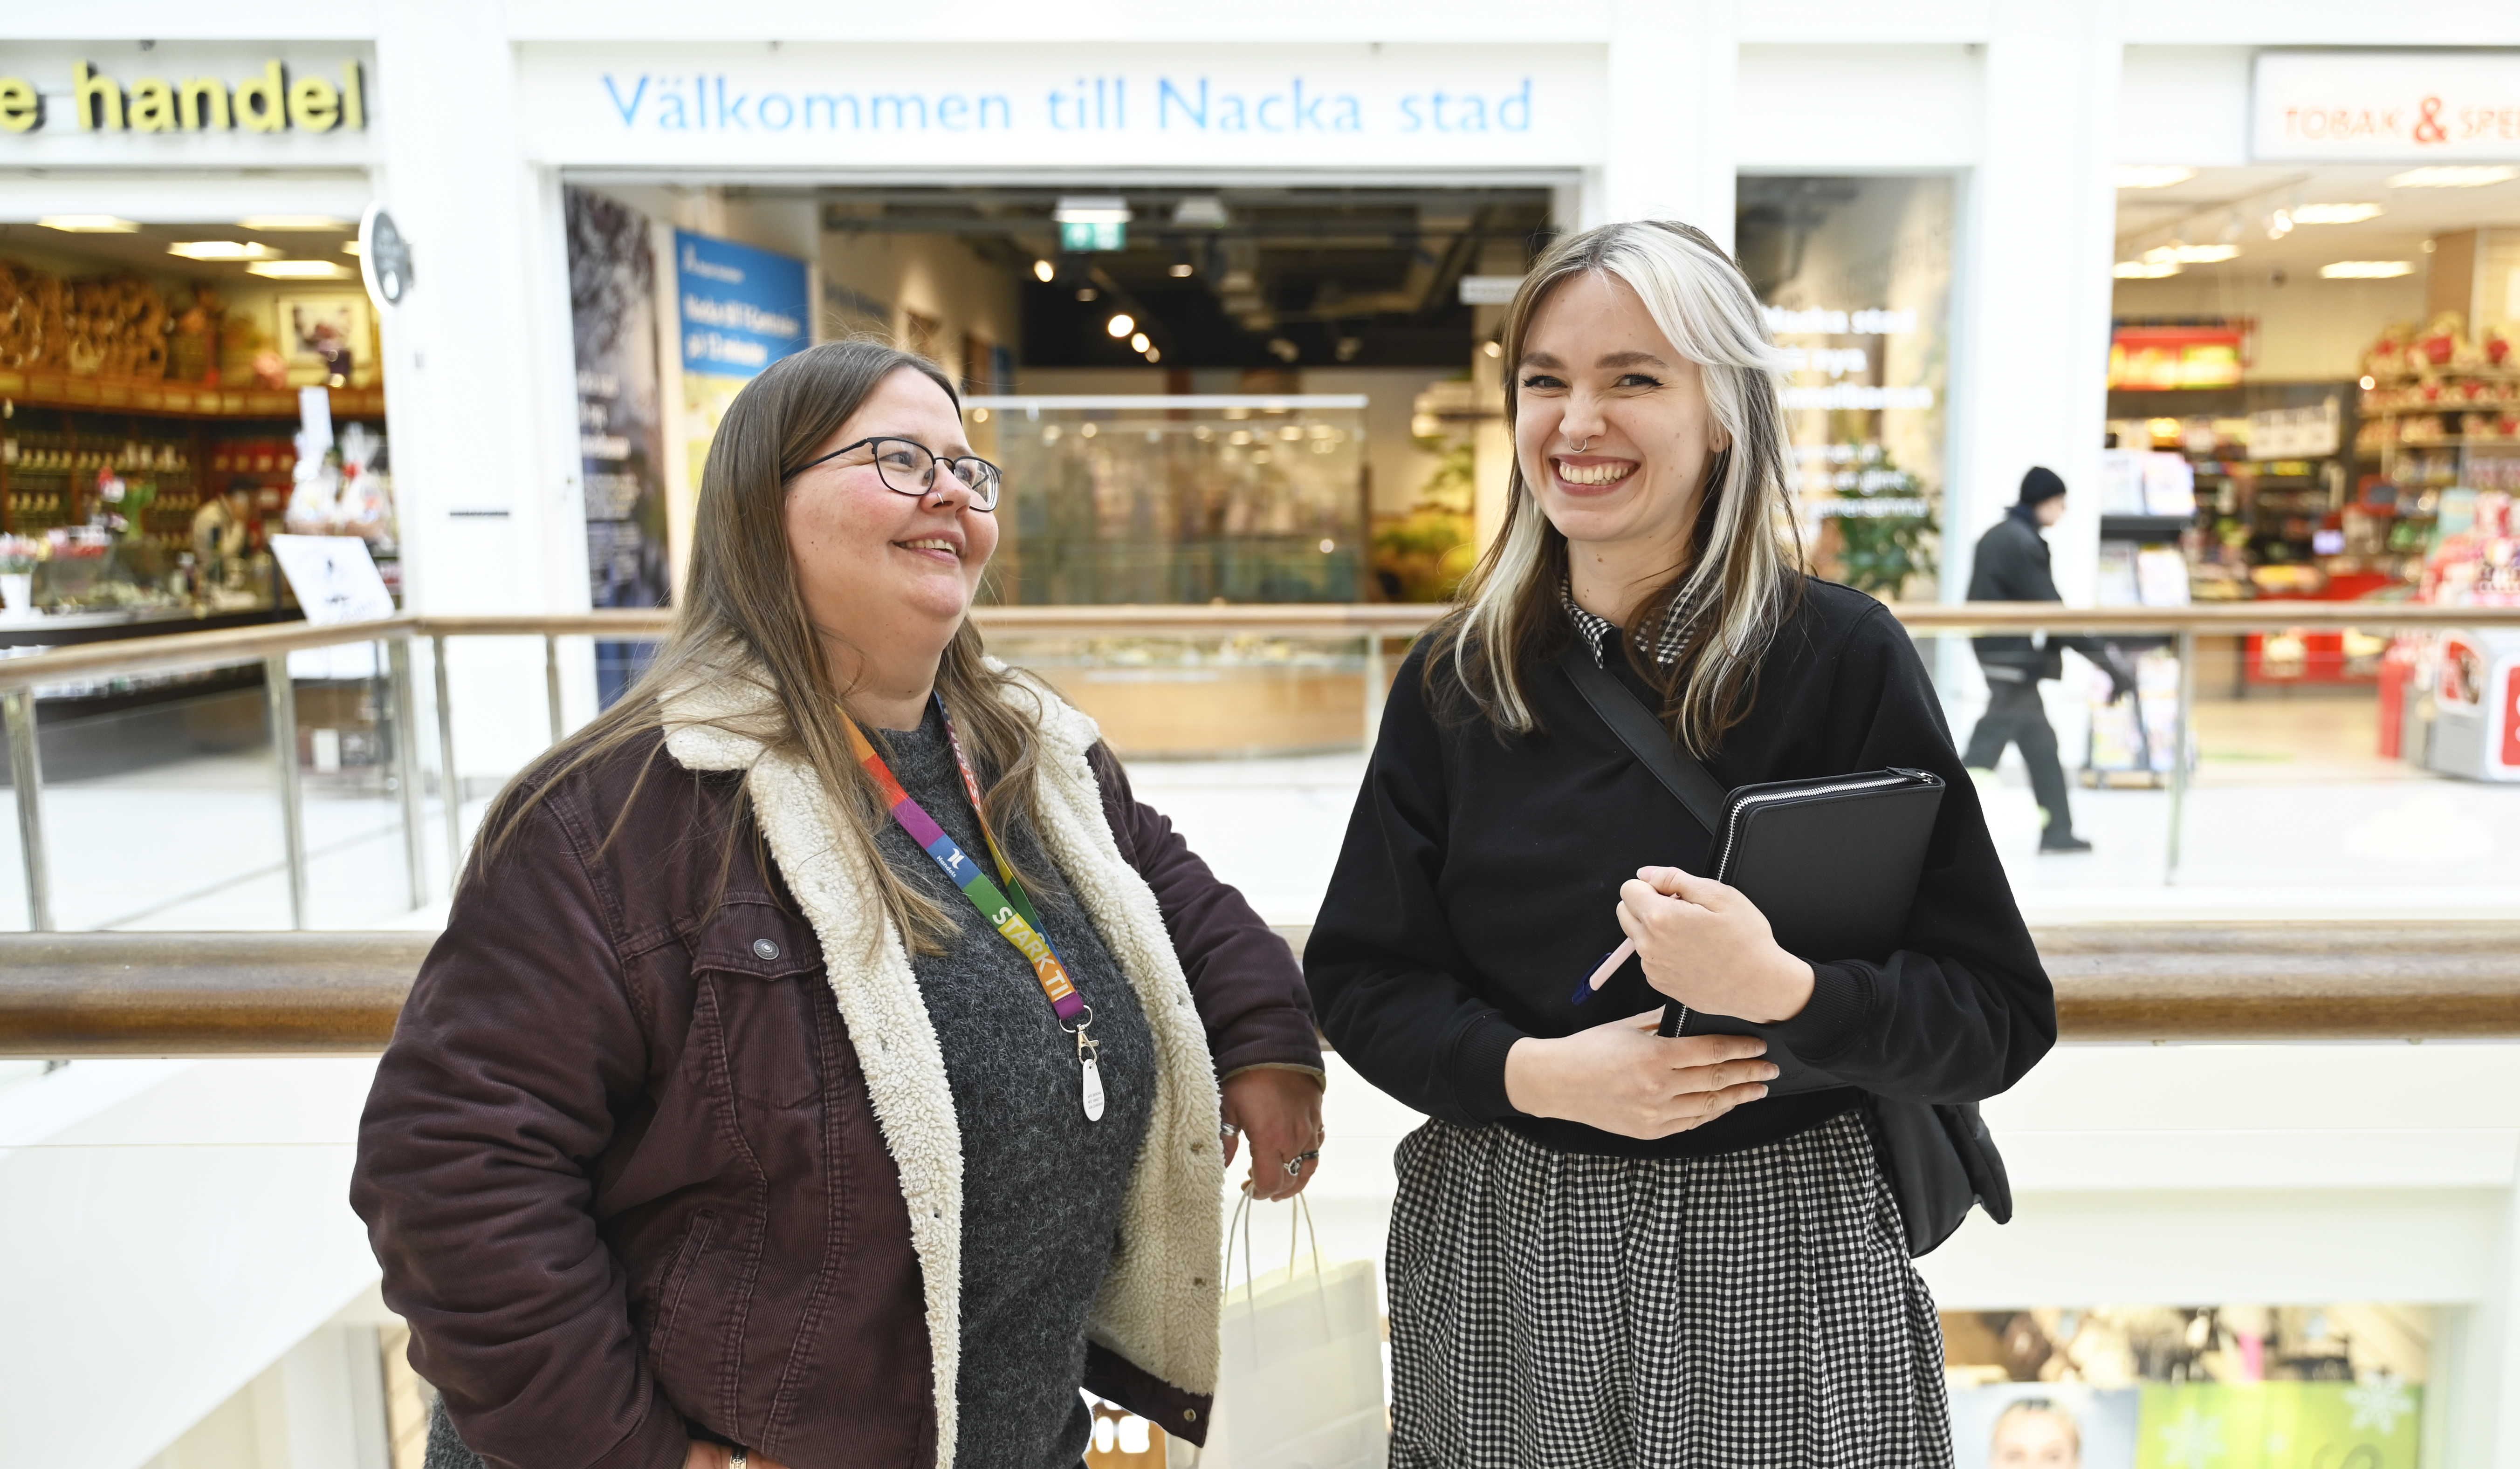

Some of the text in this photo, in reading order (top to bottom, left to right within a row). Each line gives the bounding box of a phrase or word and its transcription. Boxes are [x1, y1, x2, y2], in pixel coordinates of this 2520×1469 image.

[73, 59, 366, 134] handel
[600, 72, 1533, 133] Välkommen till Nacka stad
[2282, 94, 2520, 144] TOBAK & SPE
[936, 855, 957, 878] Handels
[992, 906, 1056, 974] STARK
